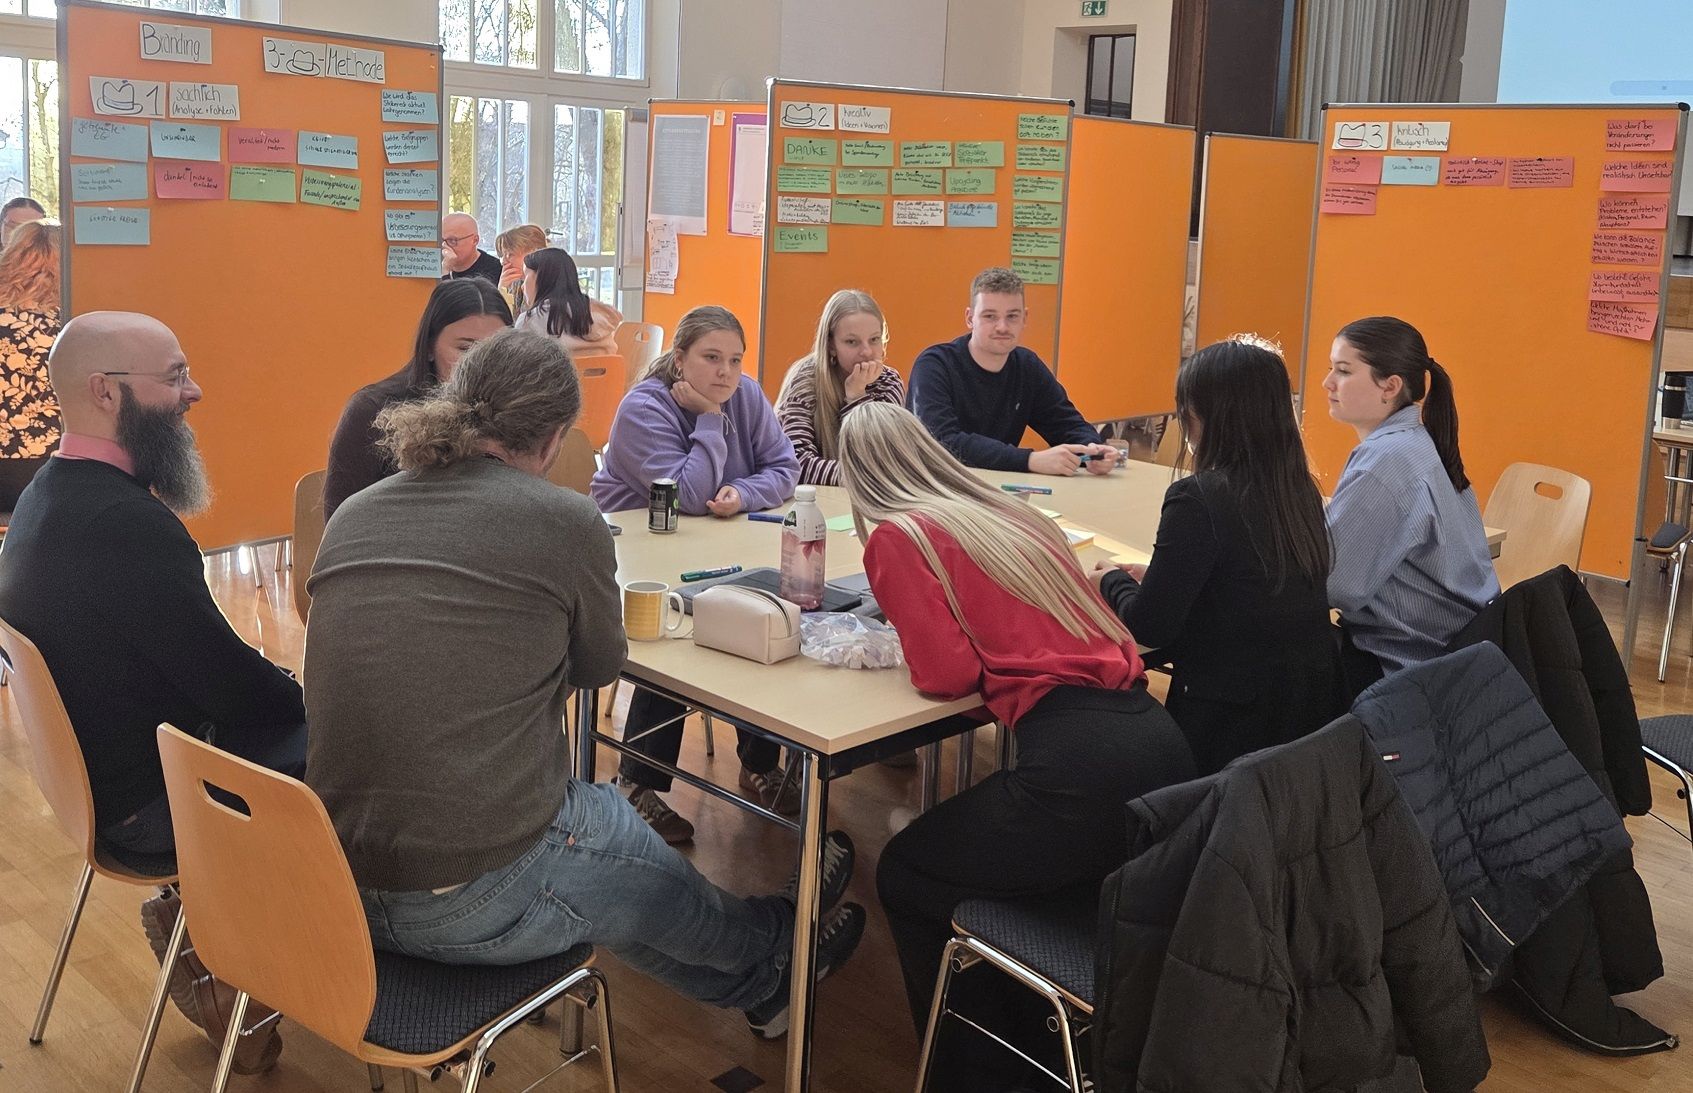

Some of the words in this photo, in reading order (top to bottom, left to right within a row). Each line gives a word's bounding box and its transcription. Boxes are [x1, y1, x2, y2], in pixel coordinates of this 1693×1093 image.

[142, 23, 201, 62] Branding
[145, 84, 161, 116] 1
[175, 85, 221, 103] sachlich
[818, 107, 830, 127] 2
[1624, 121, 1641, 130] darf
[1369, 124, 1384, 149] 3
[787, 144, 828, 156] DANKE
[1604, 162, 1629, 171] Welche
[949, 177, 982, 187] Upcycling
[779, 230, 819, 241] Events
